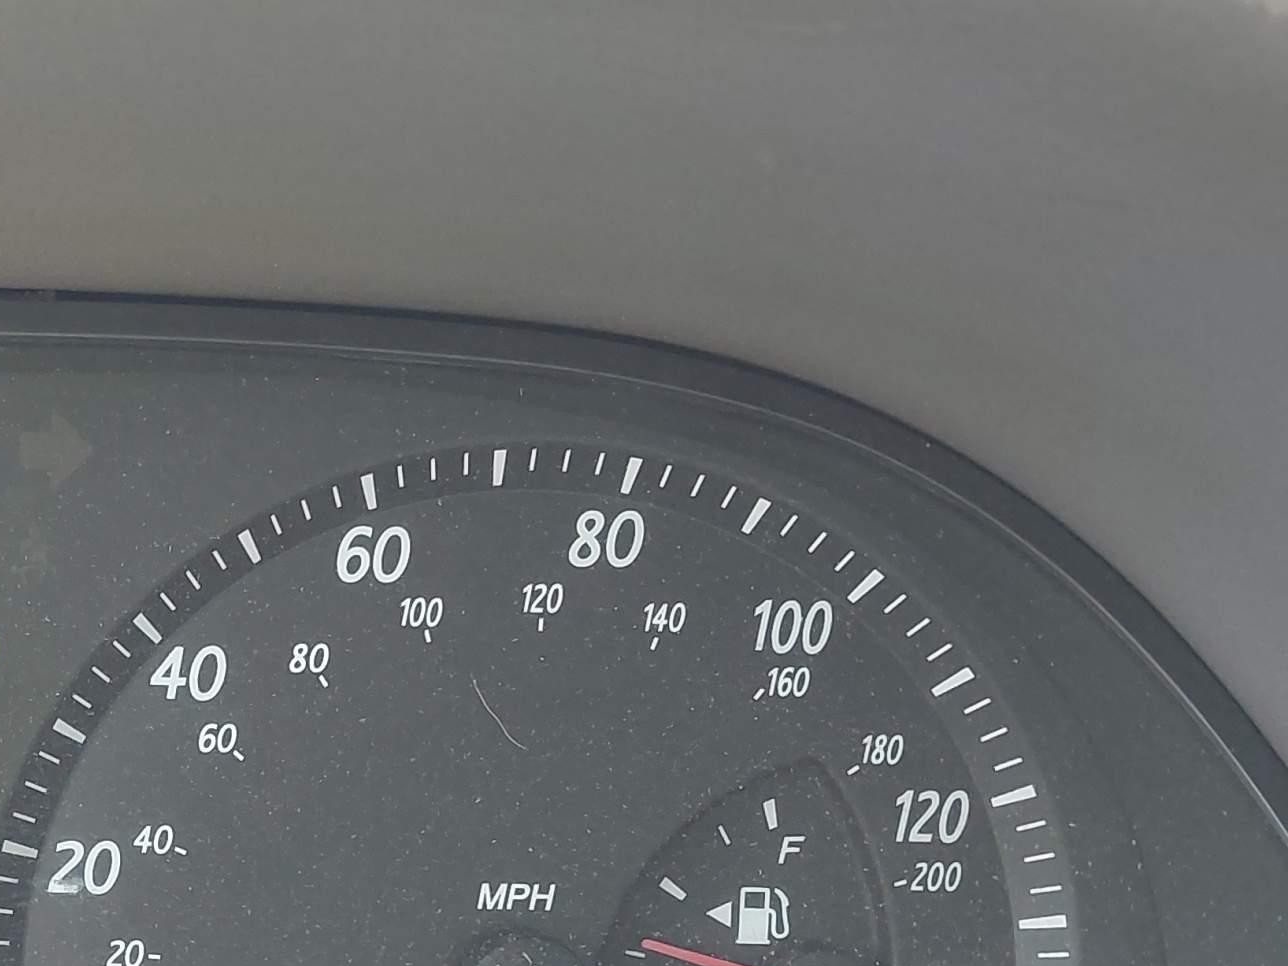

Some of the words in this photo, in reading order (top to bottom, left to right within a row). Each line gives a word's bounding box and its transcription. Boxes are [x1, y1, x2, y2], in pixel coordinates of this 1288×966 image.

[336, 526, 410, 583] 60
[568, 510, 644, 568] 80
[400, 598, 443, 628] 100
[522, 583, 564, 614] 120
[643, 603, 686, 634] 140
[752, 600, 833, 655] 100
[149, 645, 227, 702] 40
[289, 643, 329, 673] 80
[767, 667, 810, 698] 160
[198, 724, 237, 753] 60
[861, 734, 904, 765] 180
[894, 790, 969, 843] 120
[133, 825, 173, 855] 40
[778, 837, 806, 864] F
[47, 840, 120, 895] 20
[911, 862, 962, 892] 200
[477, 884, 555, 912] MPH
